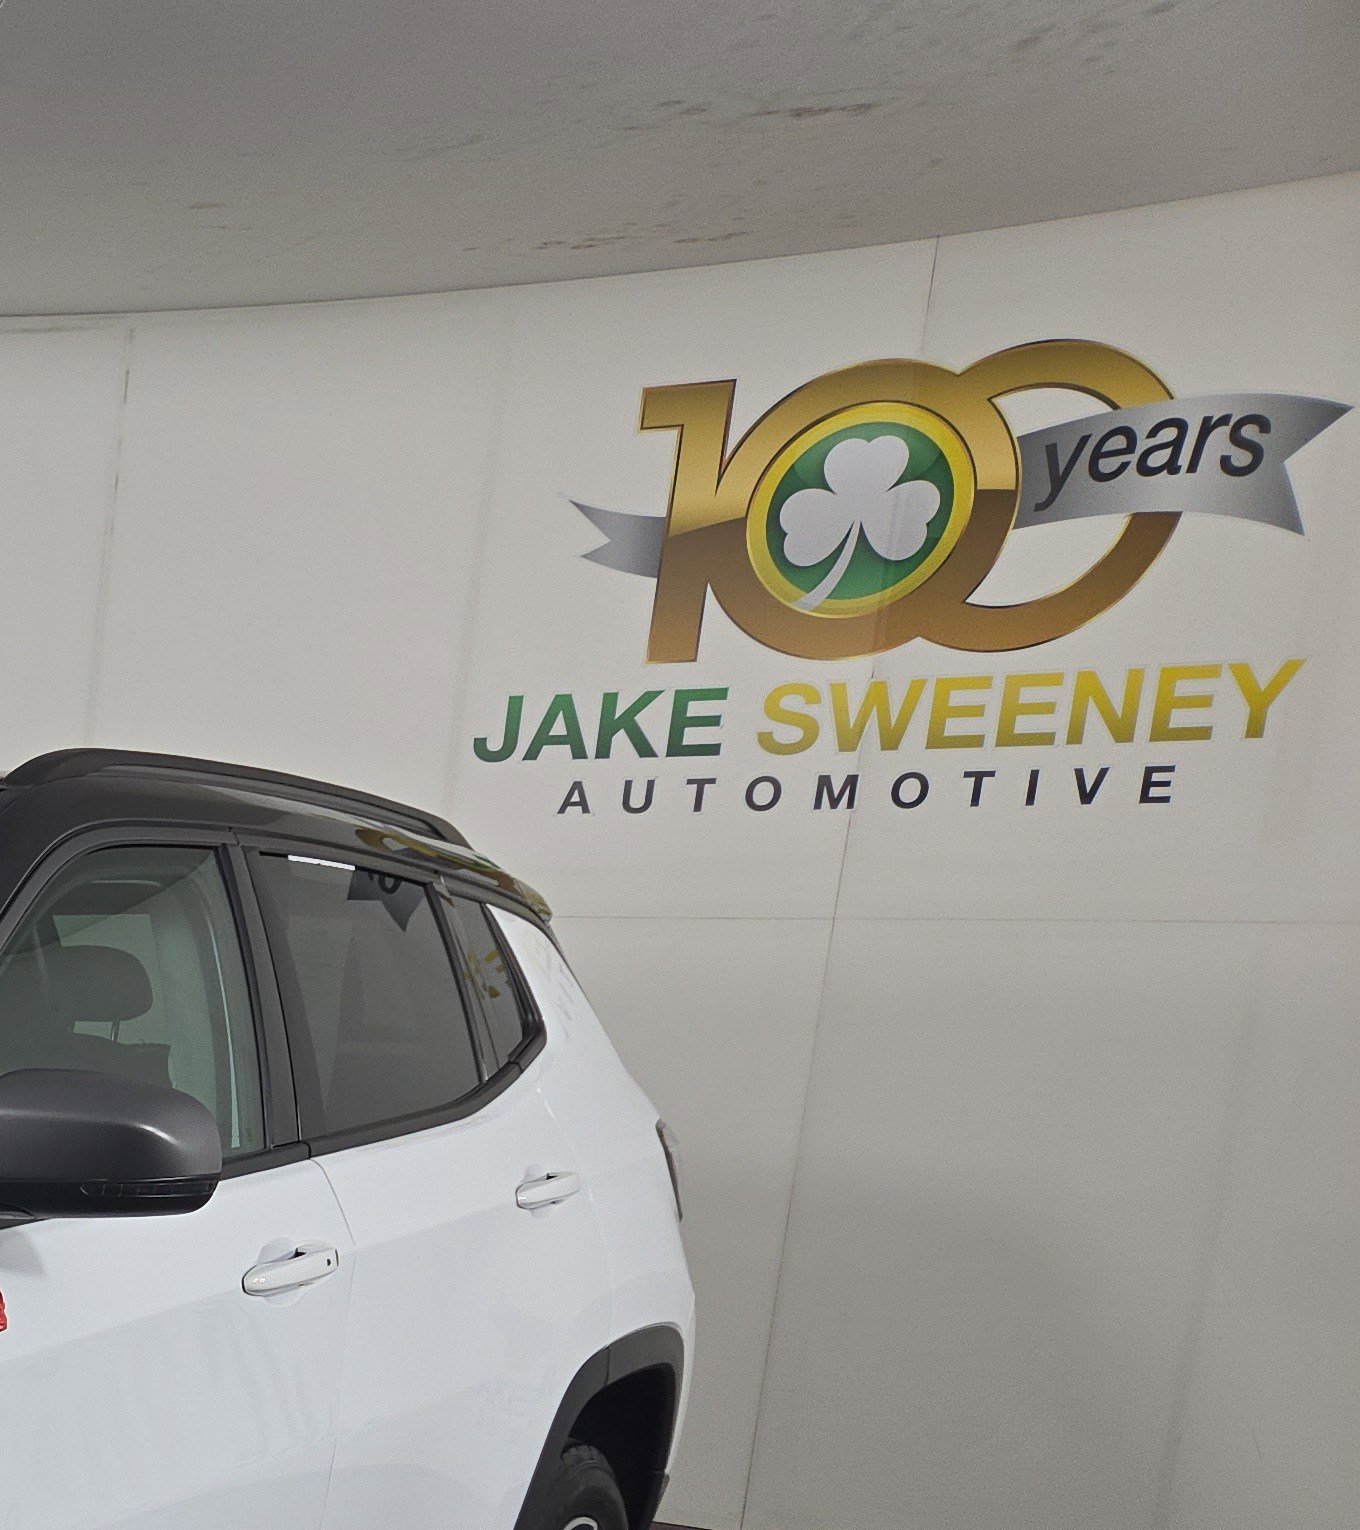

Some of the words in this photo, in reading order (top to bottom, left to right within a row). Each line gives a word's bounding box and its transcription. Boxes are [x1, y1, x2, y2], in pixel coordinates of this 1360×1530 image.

[638, 338, 1184, 665] 100
[1033, 412, 1273, 513] years
[472, 686, 730, 764] JAKE
[756, 659, 1308, 756] SWEENEY
[557, 766, 1177, 815] AUTOMOTIVE
